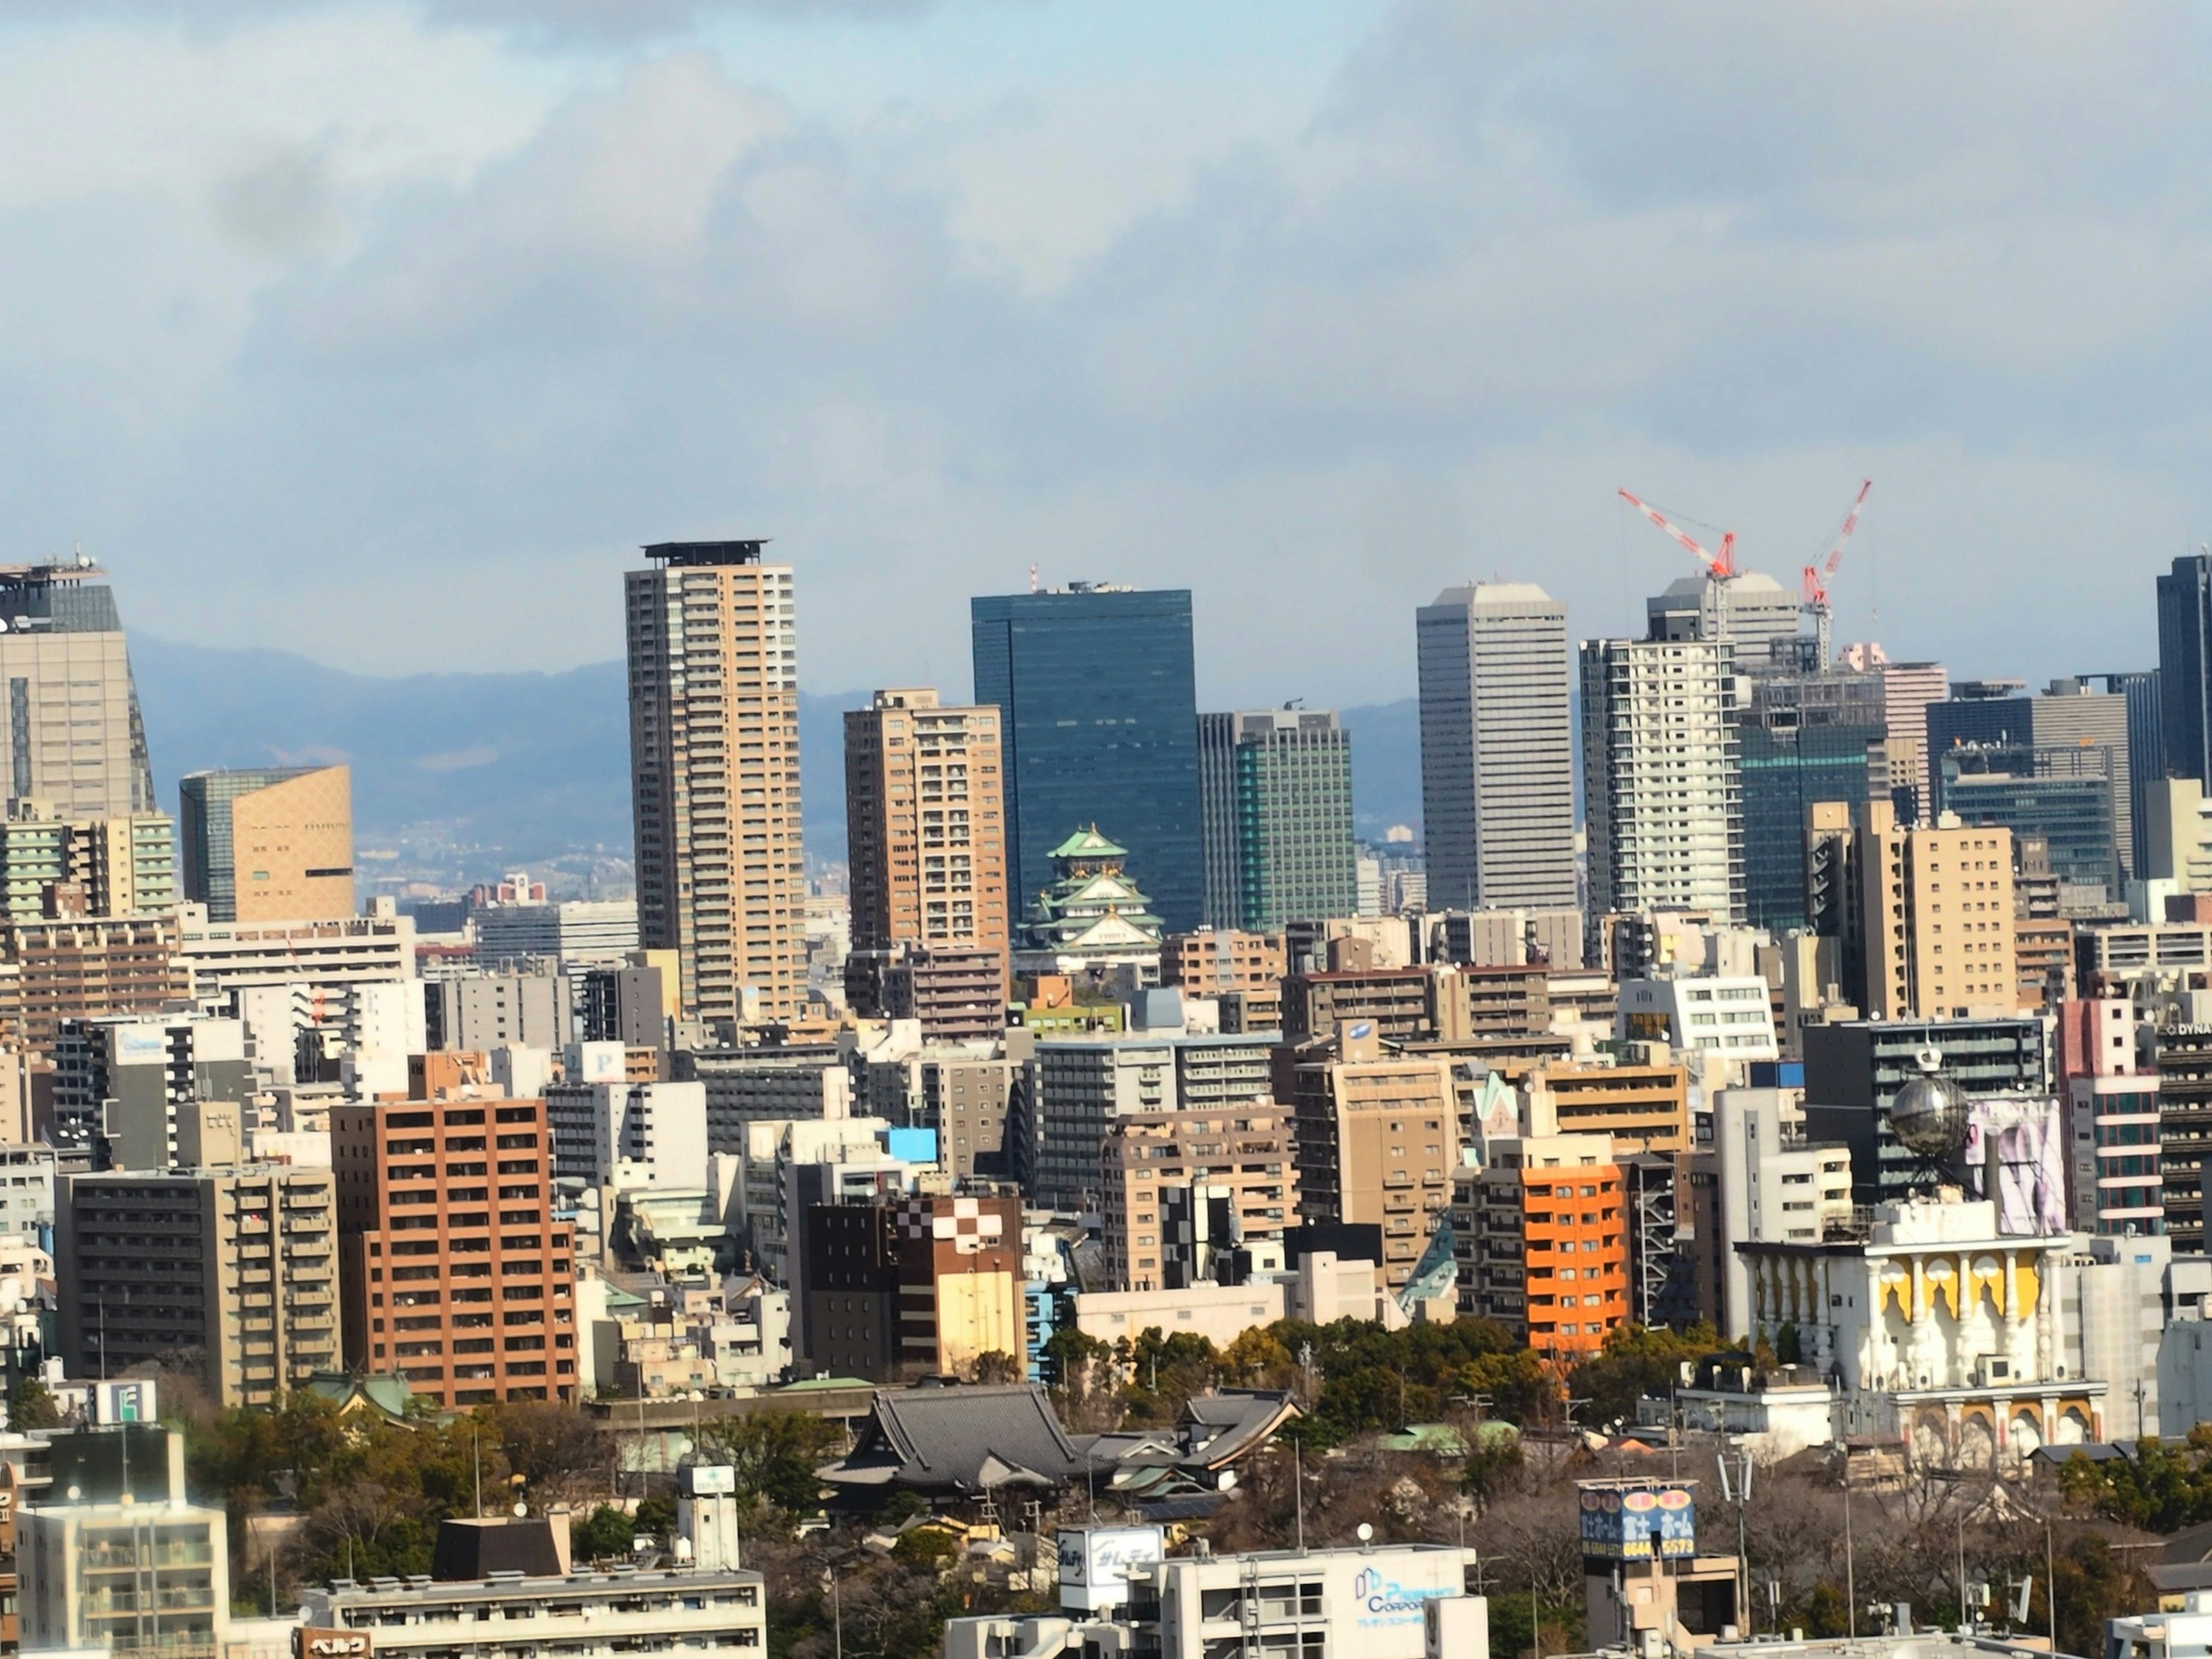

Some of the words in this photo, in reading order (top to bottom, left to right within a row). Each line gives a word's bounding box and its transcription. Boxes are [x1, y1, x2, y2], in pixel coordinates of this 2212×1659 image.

[597, 1055, 612, 1072] P
[1661, 1511, 1694, 1539] ホーム
[310, 1637, 366, 1654] ベルク
